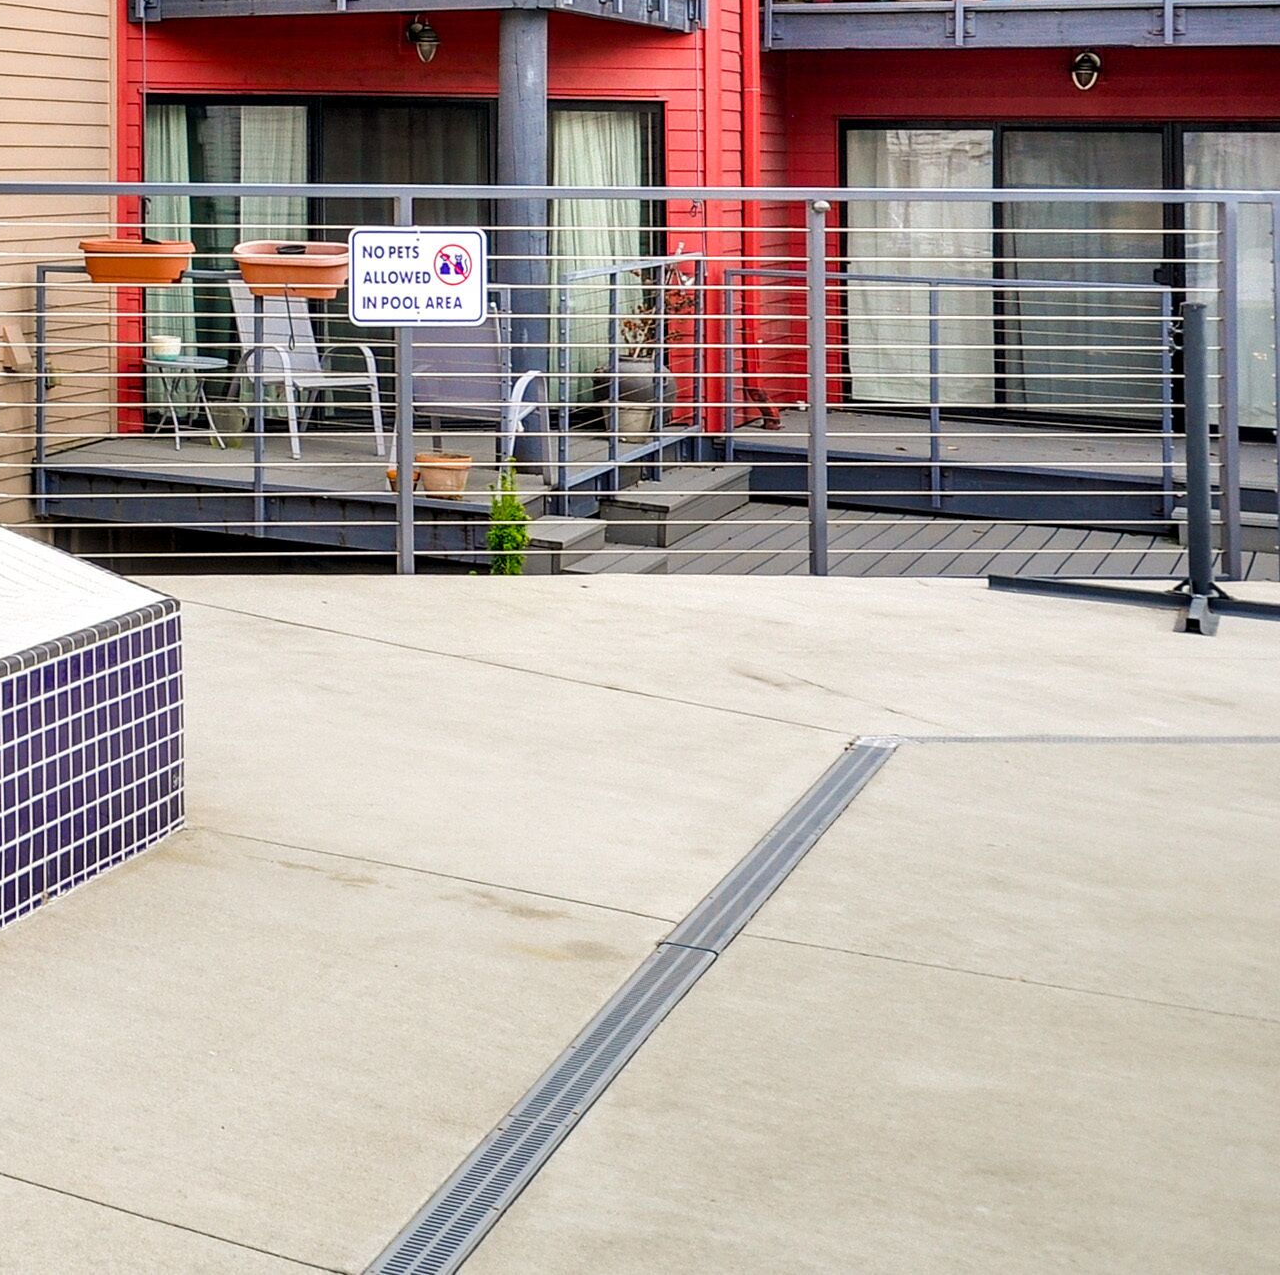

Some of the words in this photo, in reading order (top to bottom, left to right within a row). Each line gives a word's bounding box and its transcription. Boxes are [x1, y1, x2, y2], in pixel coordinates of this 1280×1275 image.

[362, 245, 385, 259] NO
[388, 245, 420, 259] PETS
[363, 270, 432, 284] ALLOWED
[362, 296, 377, 310] IN
[381, 296, 420, 310] POOL
[425, 296, 463, 310] AREA
